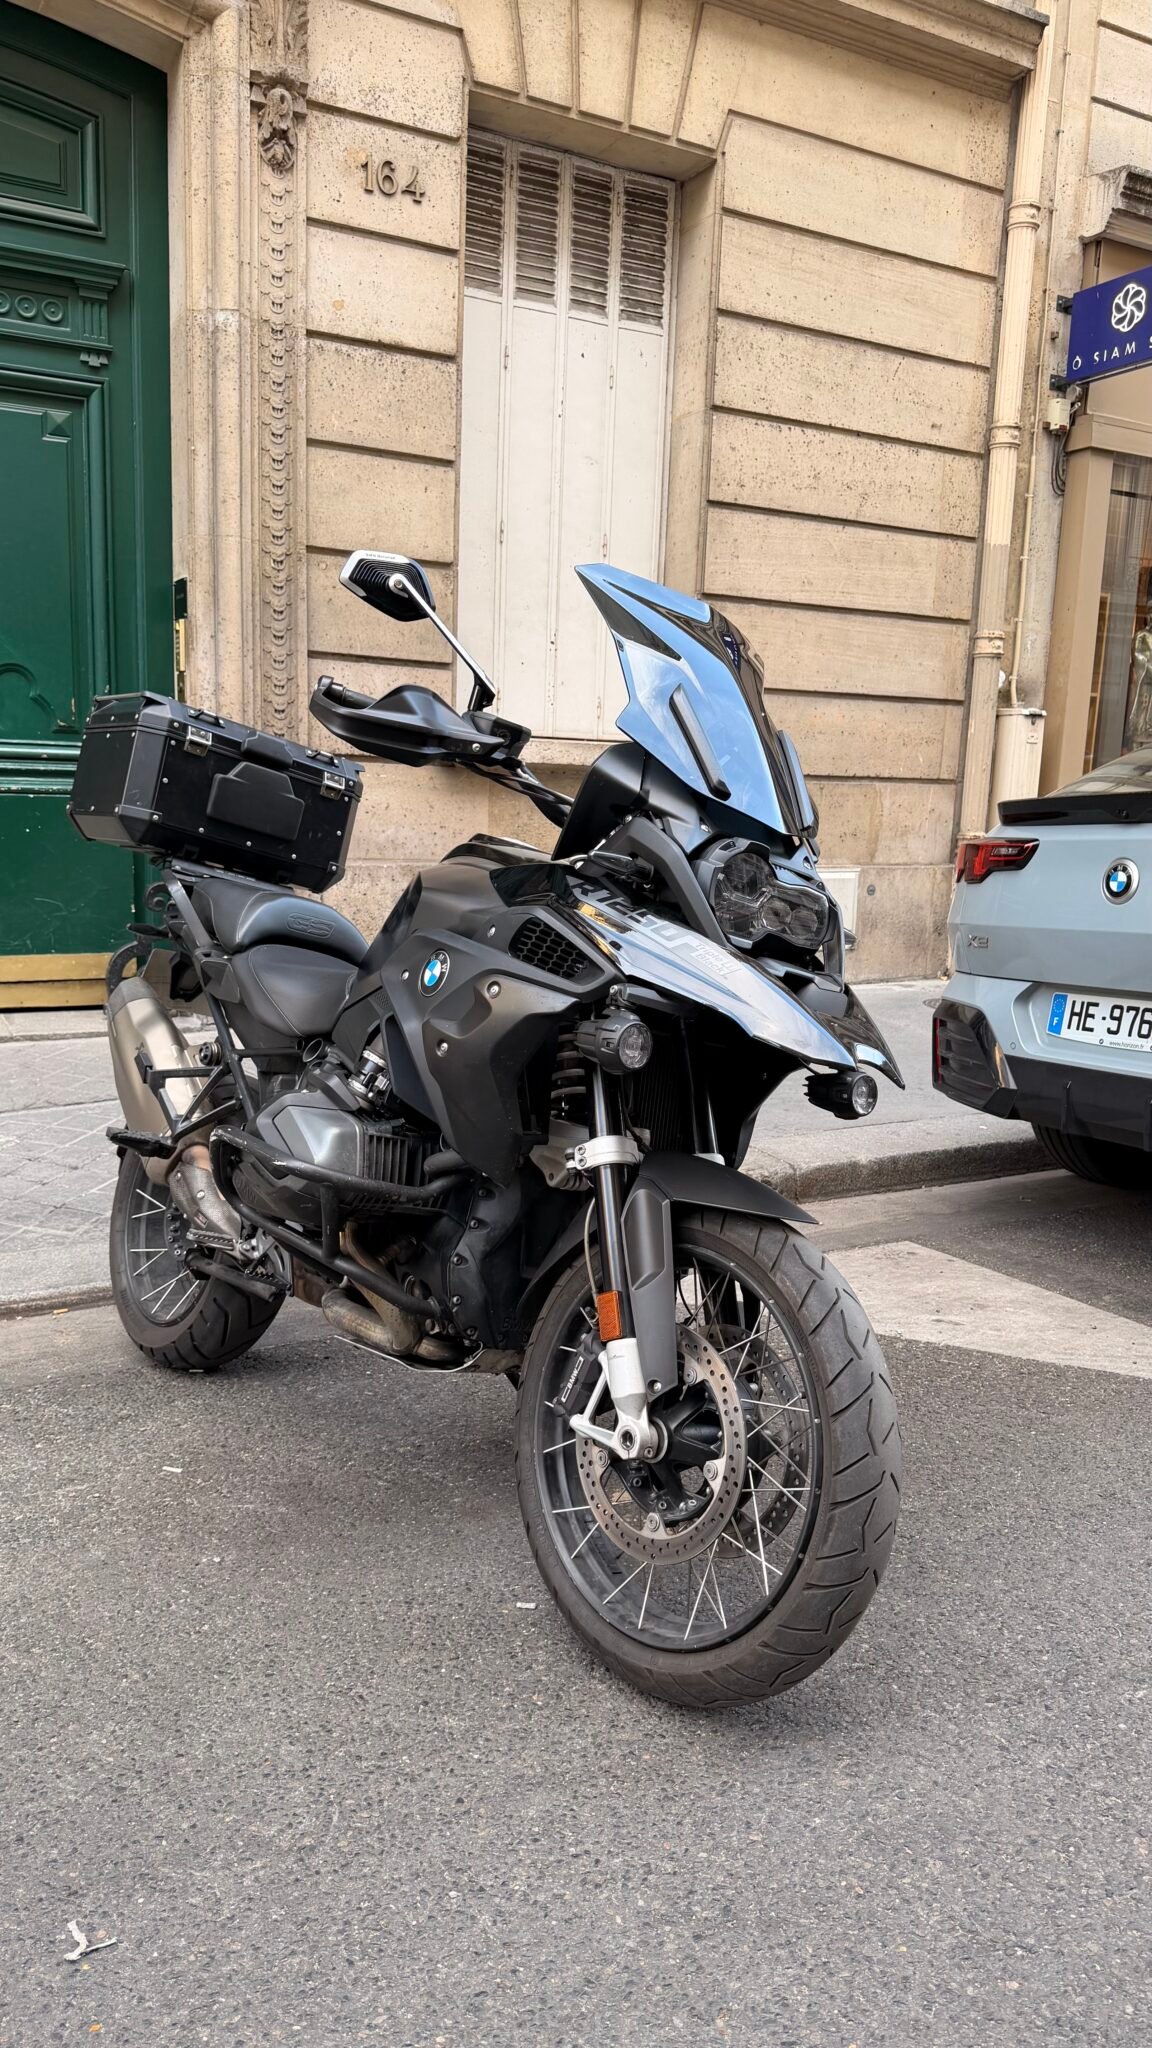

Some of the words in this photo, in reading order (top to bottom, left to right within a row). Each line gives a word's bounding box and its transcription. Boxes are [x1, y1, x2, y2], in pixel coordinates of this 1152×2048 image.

[361, 153, 425, 204] 164
[1093, 340, 1136, 364] SIAM
[1052, 1016, 1059, 1026] F
[566, 1368, 579, 1389] BMW
